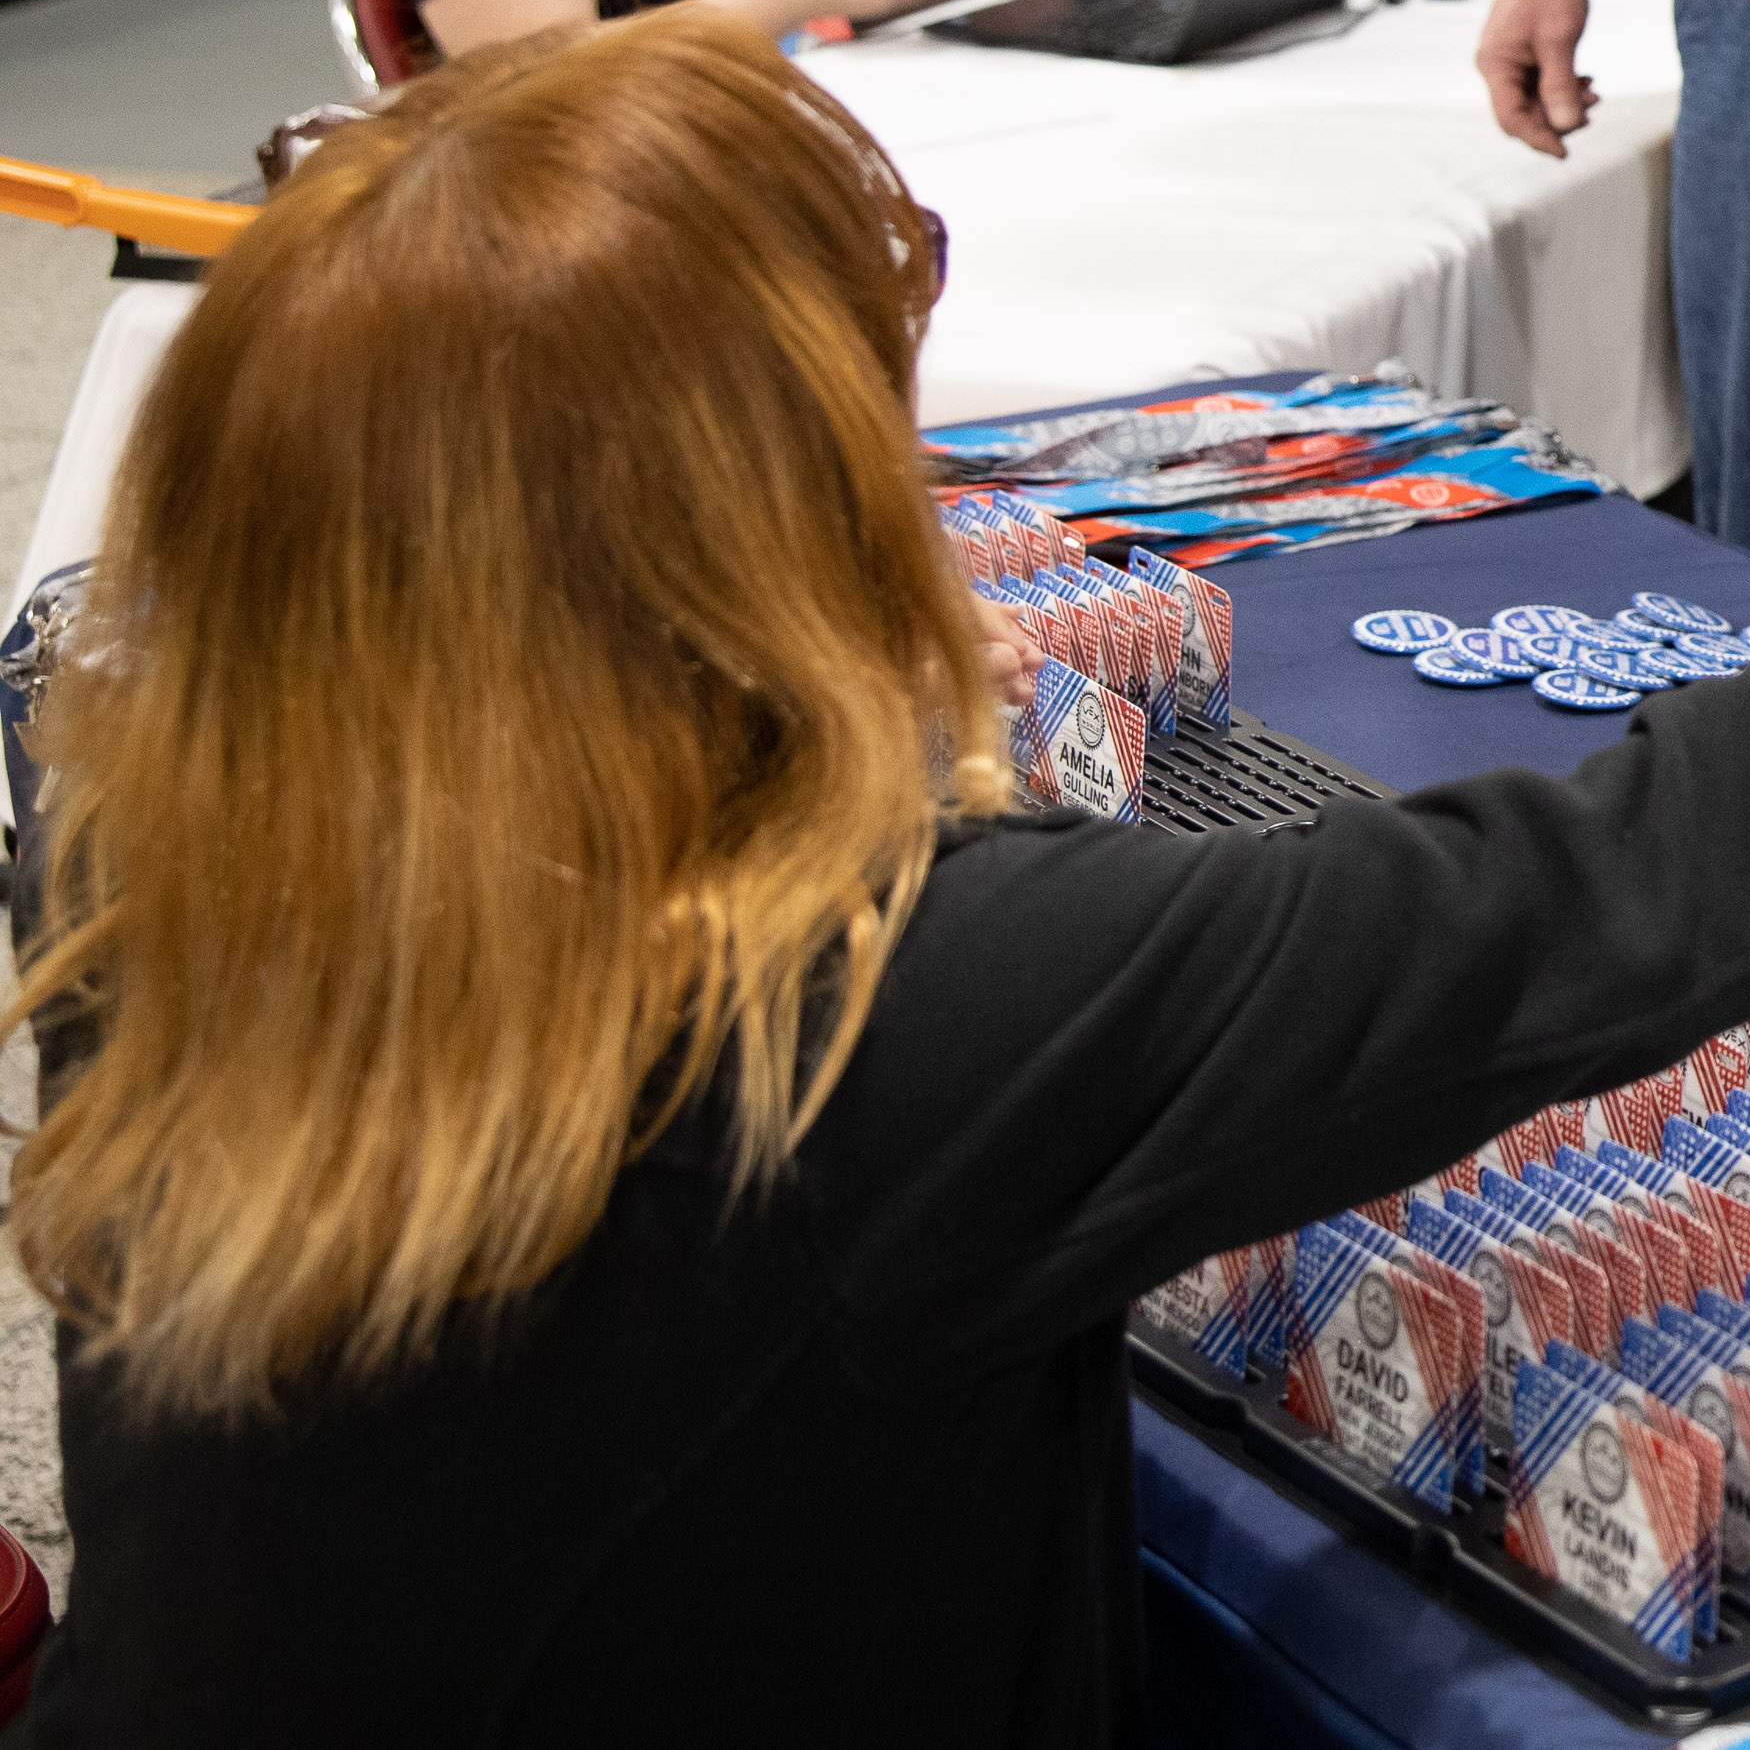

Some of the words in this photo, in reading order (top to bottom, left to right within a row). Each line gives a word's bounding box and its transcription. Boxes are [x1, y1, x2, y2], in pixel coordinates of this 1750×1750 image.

[1082, 706, 1100, 723] VEX
[1082, 718, 1101, 734] WORLD
[1060, 741, 1115, 794] AMELIA
[1063, 771, 1109, 812] GULLING
[1337, 1337, 1409, 1403] DAVID
[1561, 1489, 1637, 1561] KEVIN
